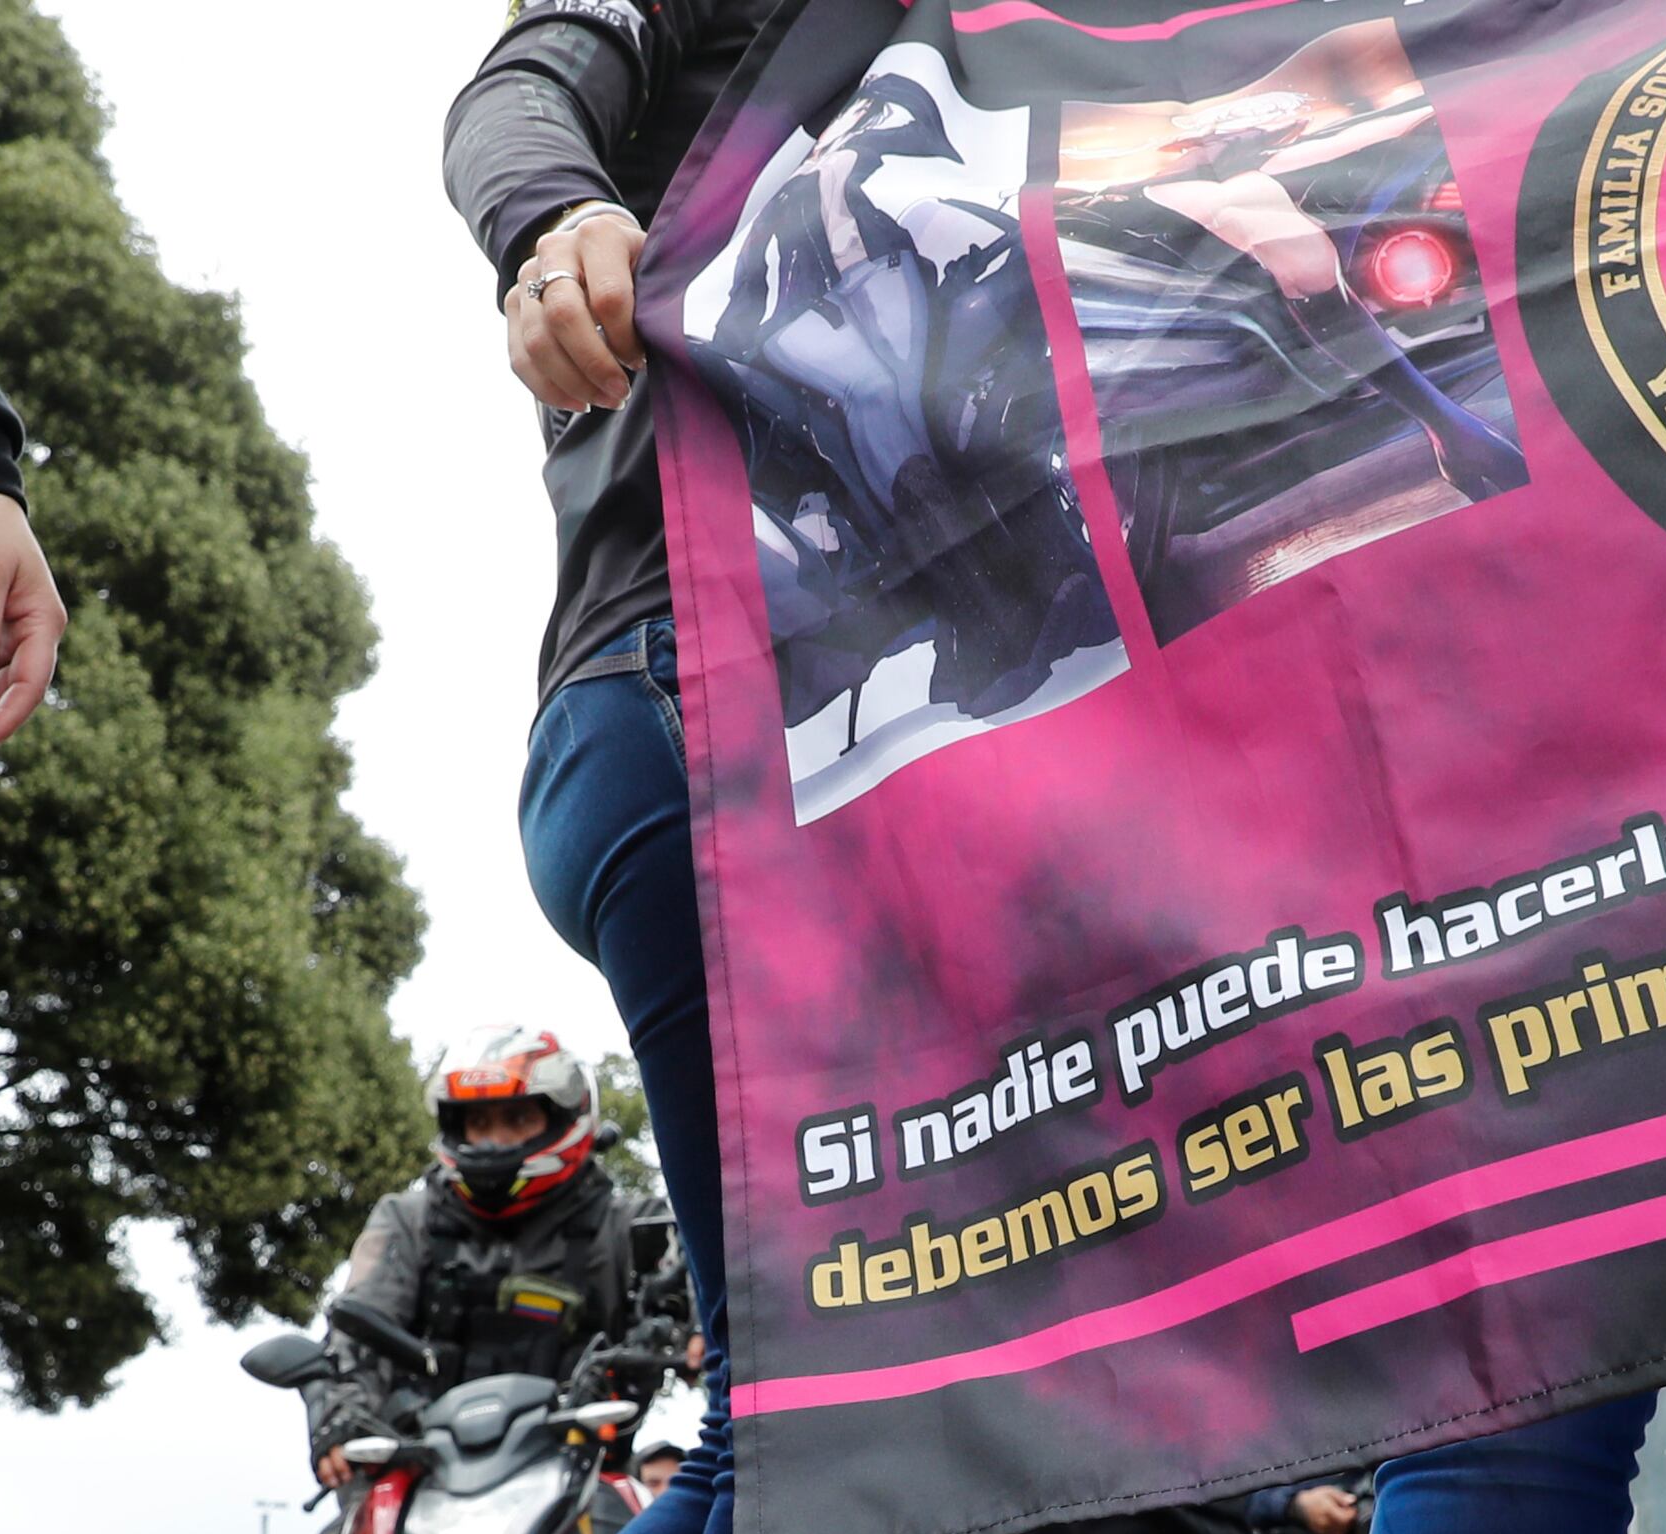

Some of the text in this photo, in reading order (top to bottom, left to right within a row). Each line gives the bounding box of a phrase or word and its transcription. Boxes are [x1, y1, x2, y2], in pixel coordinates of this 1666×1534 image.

[1597, 128, 1655, 299] FAMILIA
[801, 1113, 877, 1196] Si
[900, 1040, 1097, 1170] nadie
[1113, 936, 1357, 1094] puede
[813, 1154, 1160, 1307] debemos
[1183, 1087, 1303, 1190] ser
[1323, 1032, 1465, 1128] las
